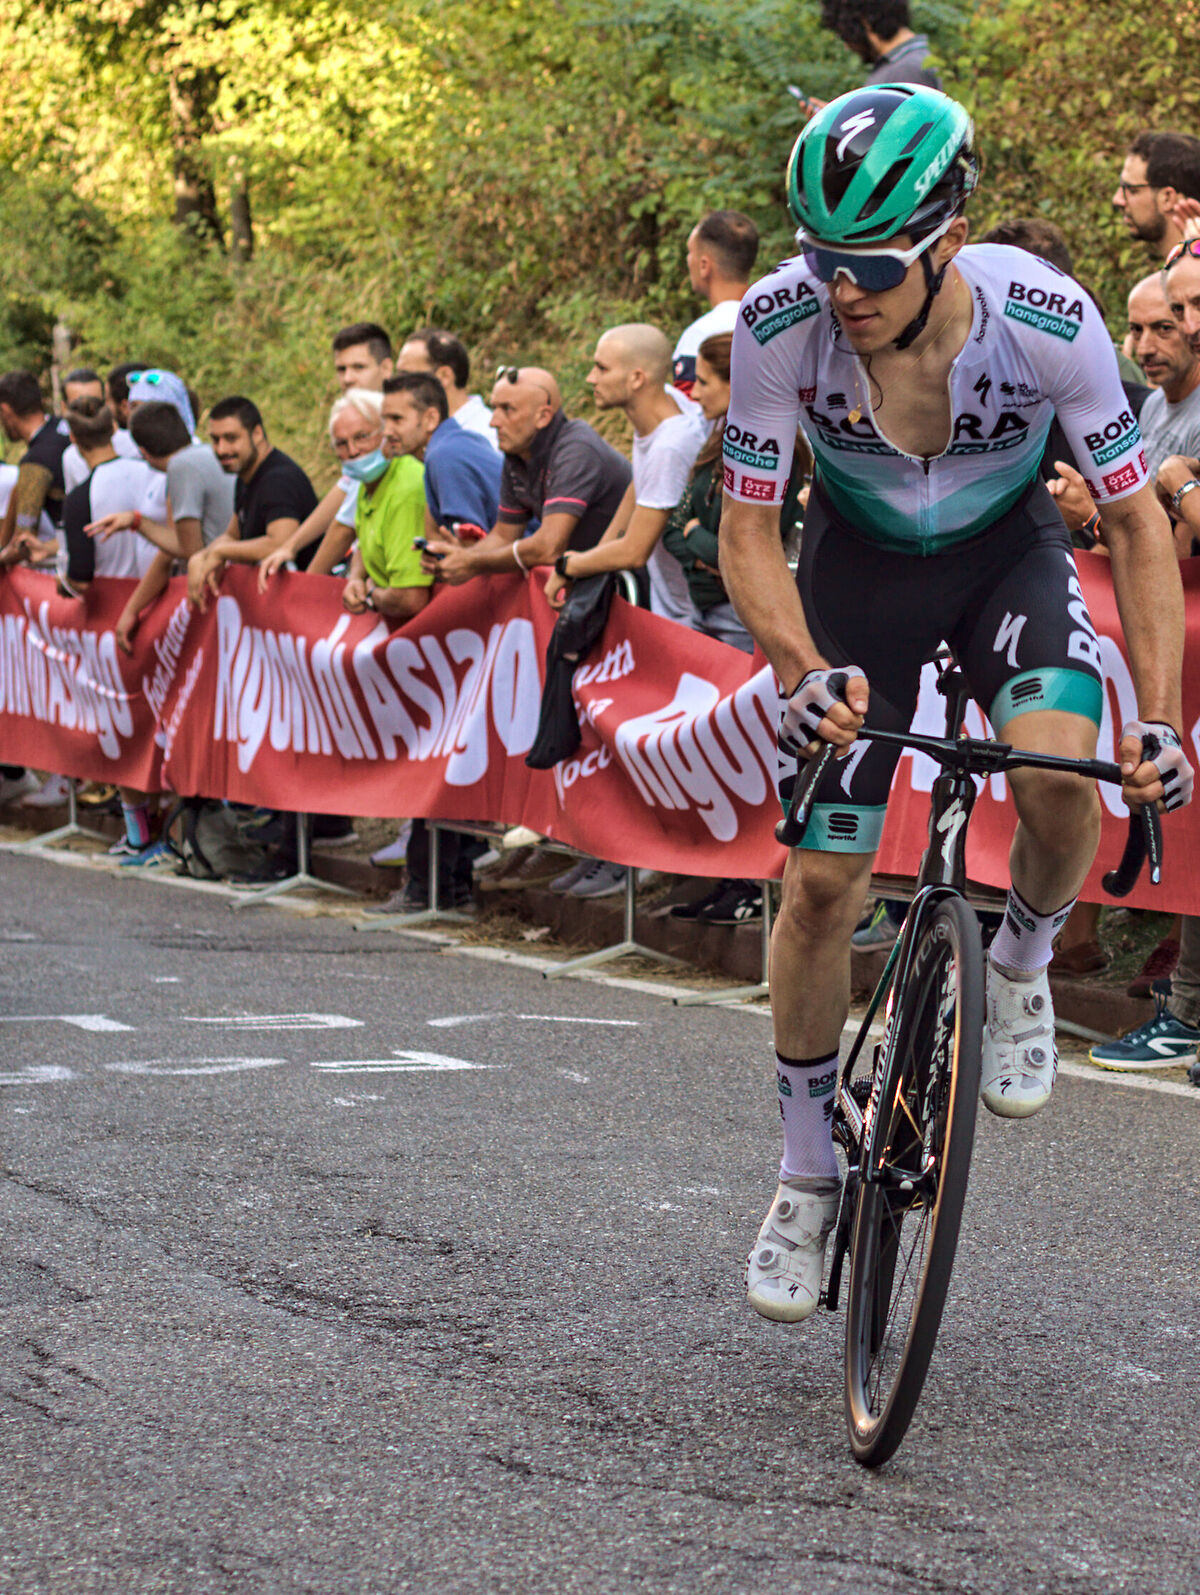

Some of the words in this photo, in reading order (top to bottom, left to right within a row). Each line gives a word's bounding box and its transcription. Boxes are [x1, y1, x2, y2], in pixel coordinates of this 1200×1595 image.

[741, 281, 815, 328] BORA
[754, 301, 818, 340] hansgrohe
[1006, 300, 1076, 337] hansgrohe
[1008, 281, 1083, 323] BORA
[723, 424, 780, 455] ORA
[1083, 411, 1138, 452] BOR
